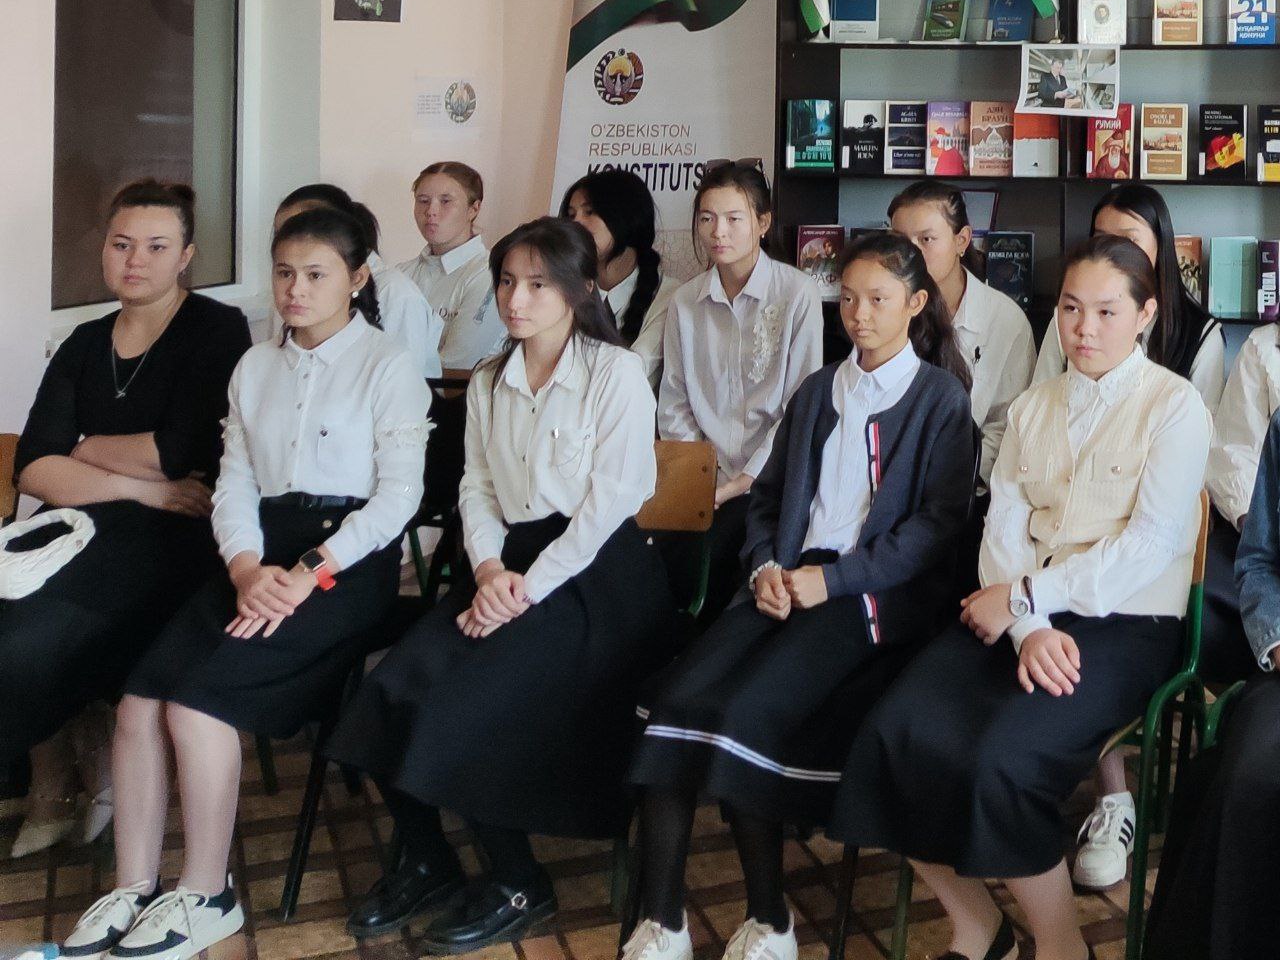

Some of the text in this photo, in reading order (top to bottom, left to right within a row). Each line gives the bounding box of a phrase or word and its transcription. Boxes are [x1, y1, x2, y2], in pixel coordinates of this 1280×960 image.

[590, 123, 691, 138] O'ZBEKISTON
[588, 142, 697, 157] RESPUBLIKASI
[587, 162, 706, 191] TITUTS
